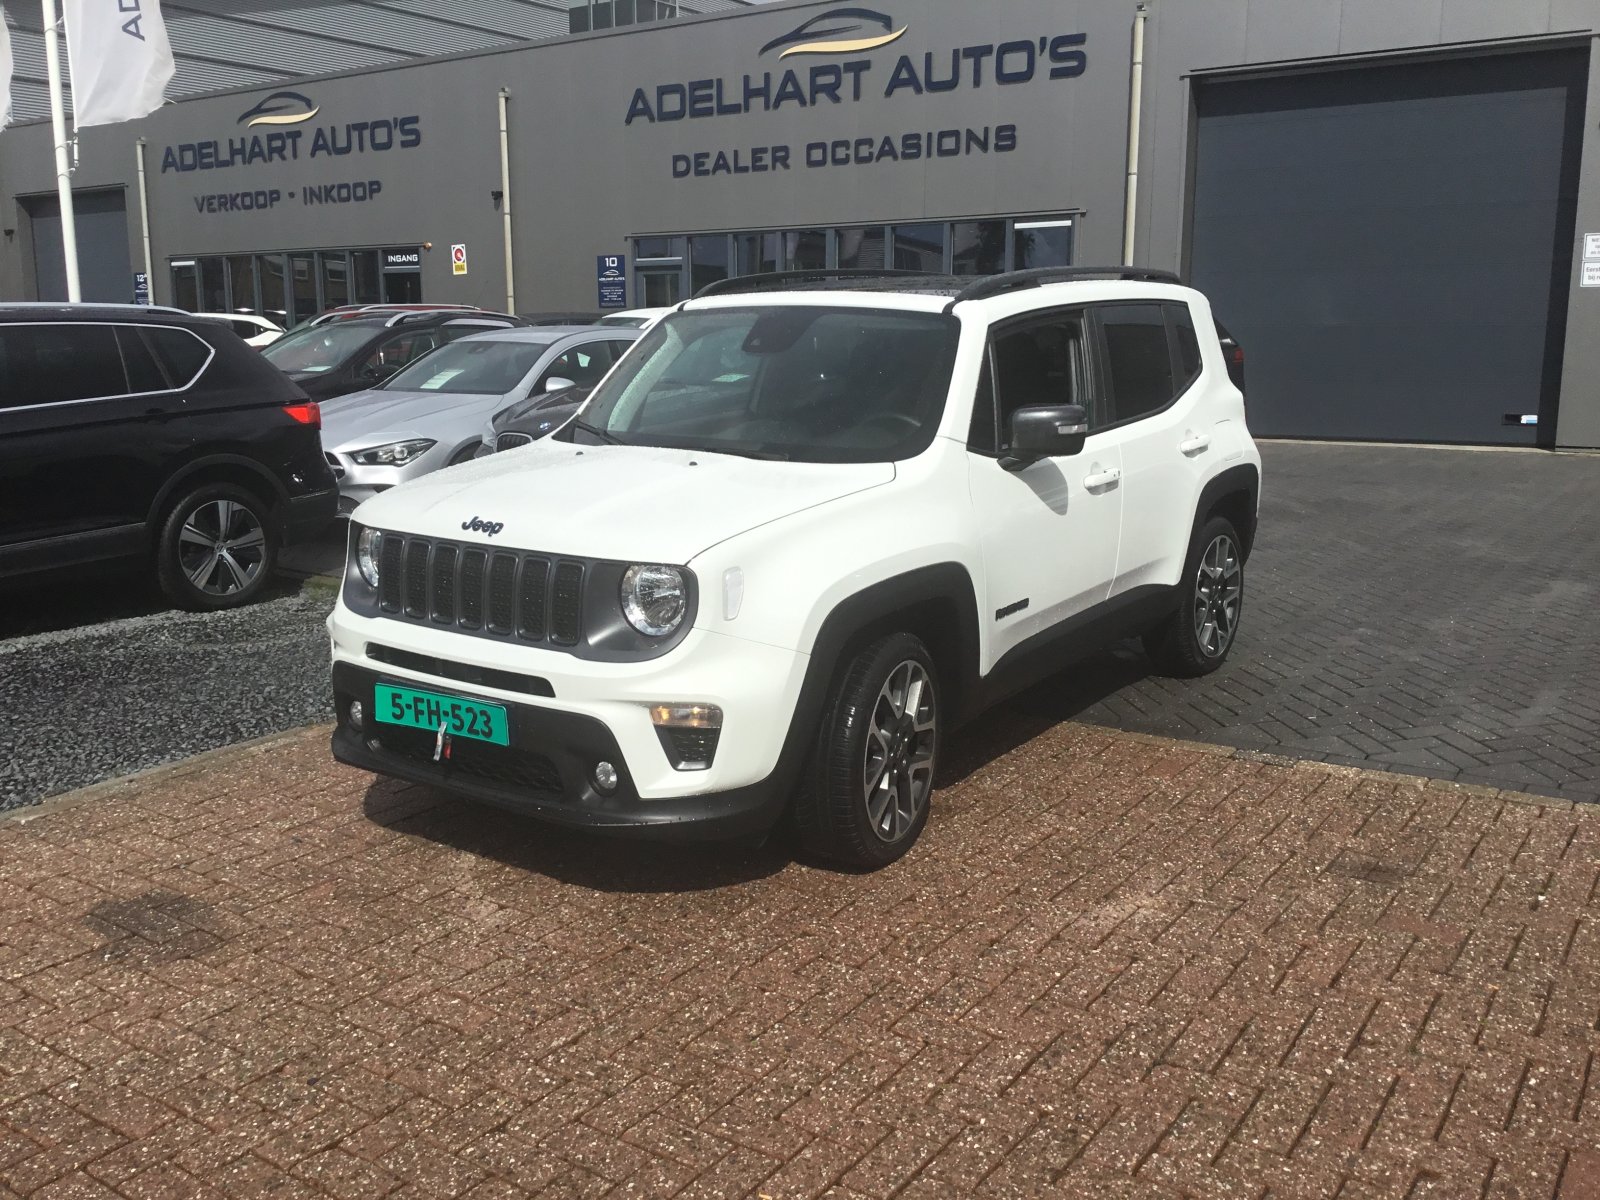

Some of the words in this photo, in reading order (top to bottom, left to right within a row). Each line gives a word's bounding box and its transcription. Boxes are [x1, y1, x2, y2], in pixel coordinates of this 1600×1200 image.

[625, 59, 871, 126] ADELHART
[884, 33, 1087, 98] AUTO'S
[161, 130, 302, 174] ADELHART
[310, 115, 421, 158] AUTO'S
[672, 145, 791, 178] DEALER
[806, 124, 1017, 168] OCCASIONS
[194, 189, 281, 213] VERKOOP
[303, 180, 382, 205] INKOOP
[388, 254, 418, 262] INGANG
[605, 257, 618, 267] 10
[461, 516, 504, 537] Jeep
[391, 692, 493, 739] 5-FH-523
